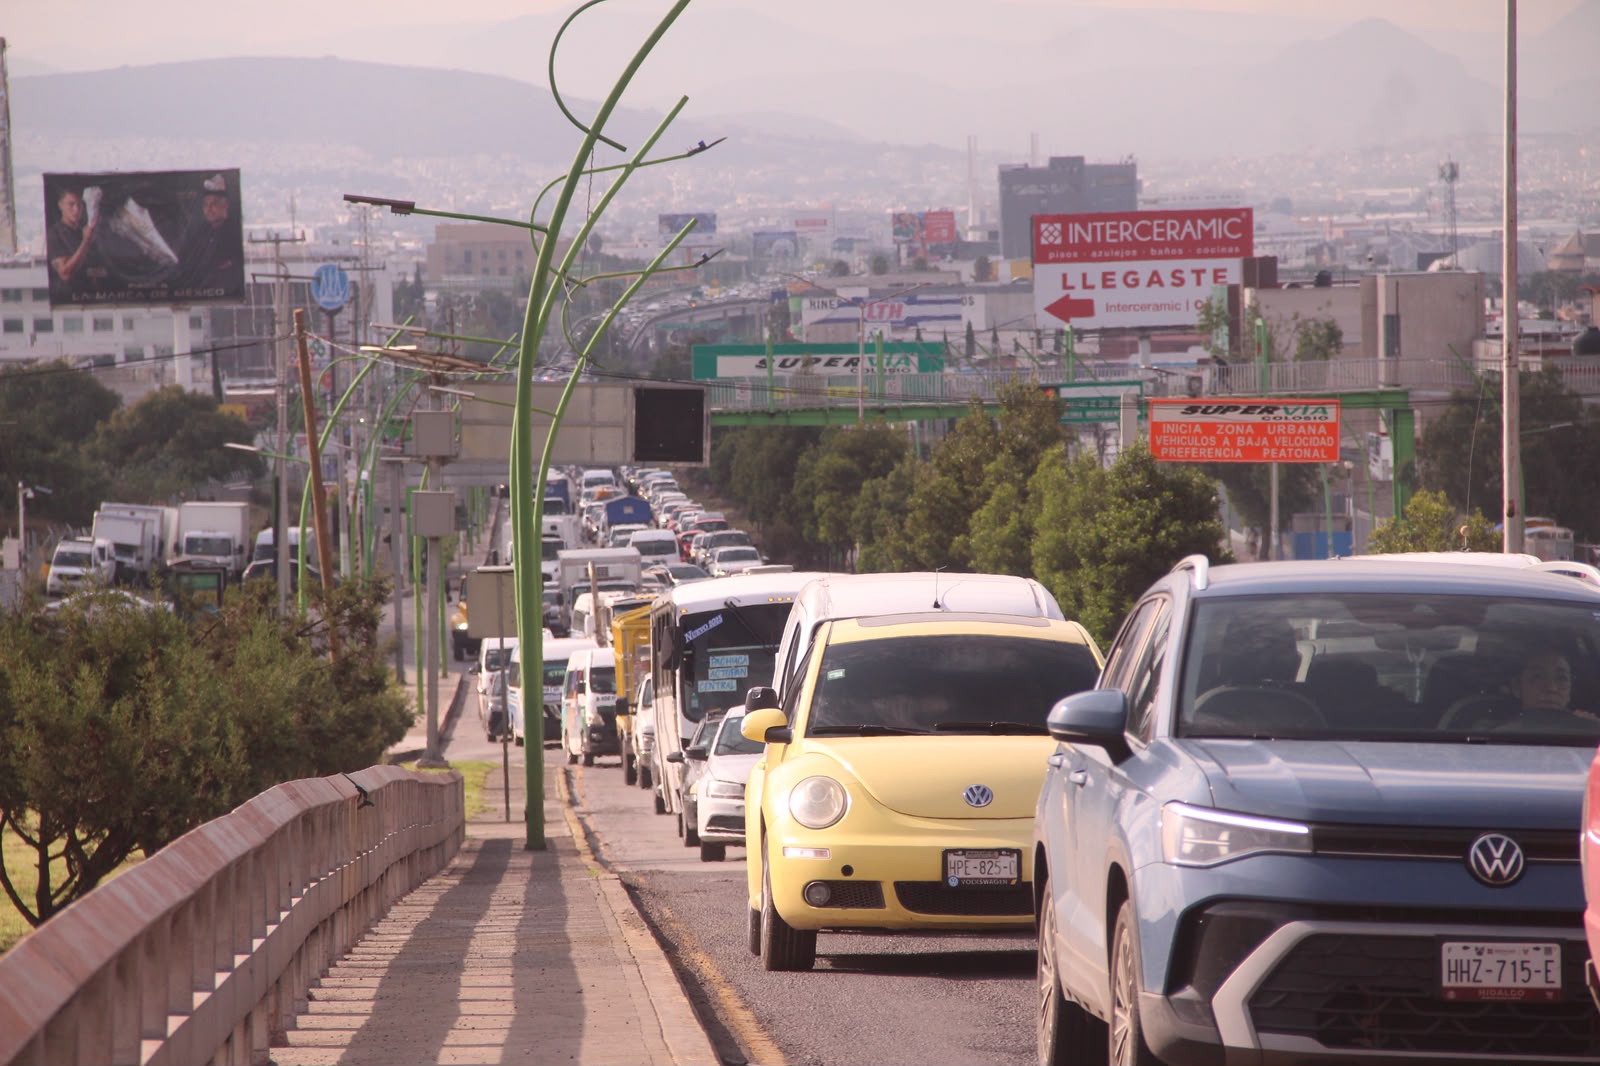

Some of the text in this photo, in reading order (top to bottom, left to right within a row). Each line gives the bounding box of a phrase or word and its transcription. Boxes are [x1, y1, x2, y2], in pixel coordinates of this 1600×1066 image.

[1068, 217, 1243, 244] INTERCERAMIC
[1048, 245, 1240, 260] pisos azulejos baños cocinas
[1061, 267, 1229, 290] LLEGASTE
[866, 303, 904, 320] LTH
[1105, 301, 1182, 313] Interceramic
[1162, 424, 1327, 435] INICIA ZONA URBANA
[1155, 435, 1335, 447] VEHICULOS A BAJA VELOCIDAD
[1161, 447, 1328, 459] PREFERENCIA PEATONAL
[699, 680, 735, 691] CENTRAL
[1447, 958, 1556, 984] HHZ-715-E
[1478, 989, 1525, 997] HIDALGO
